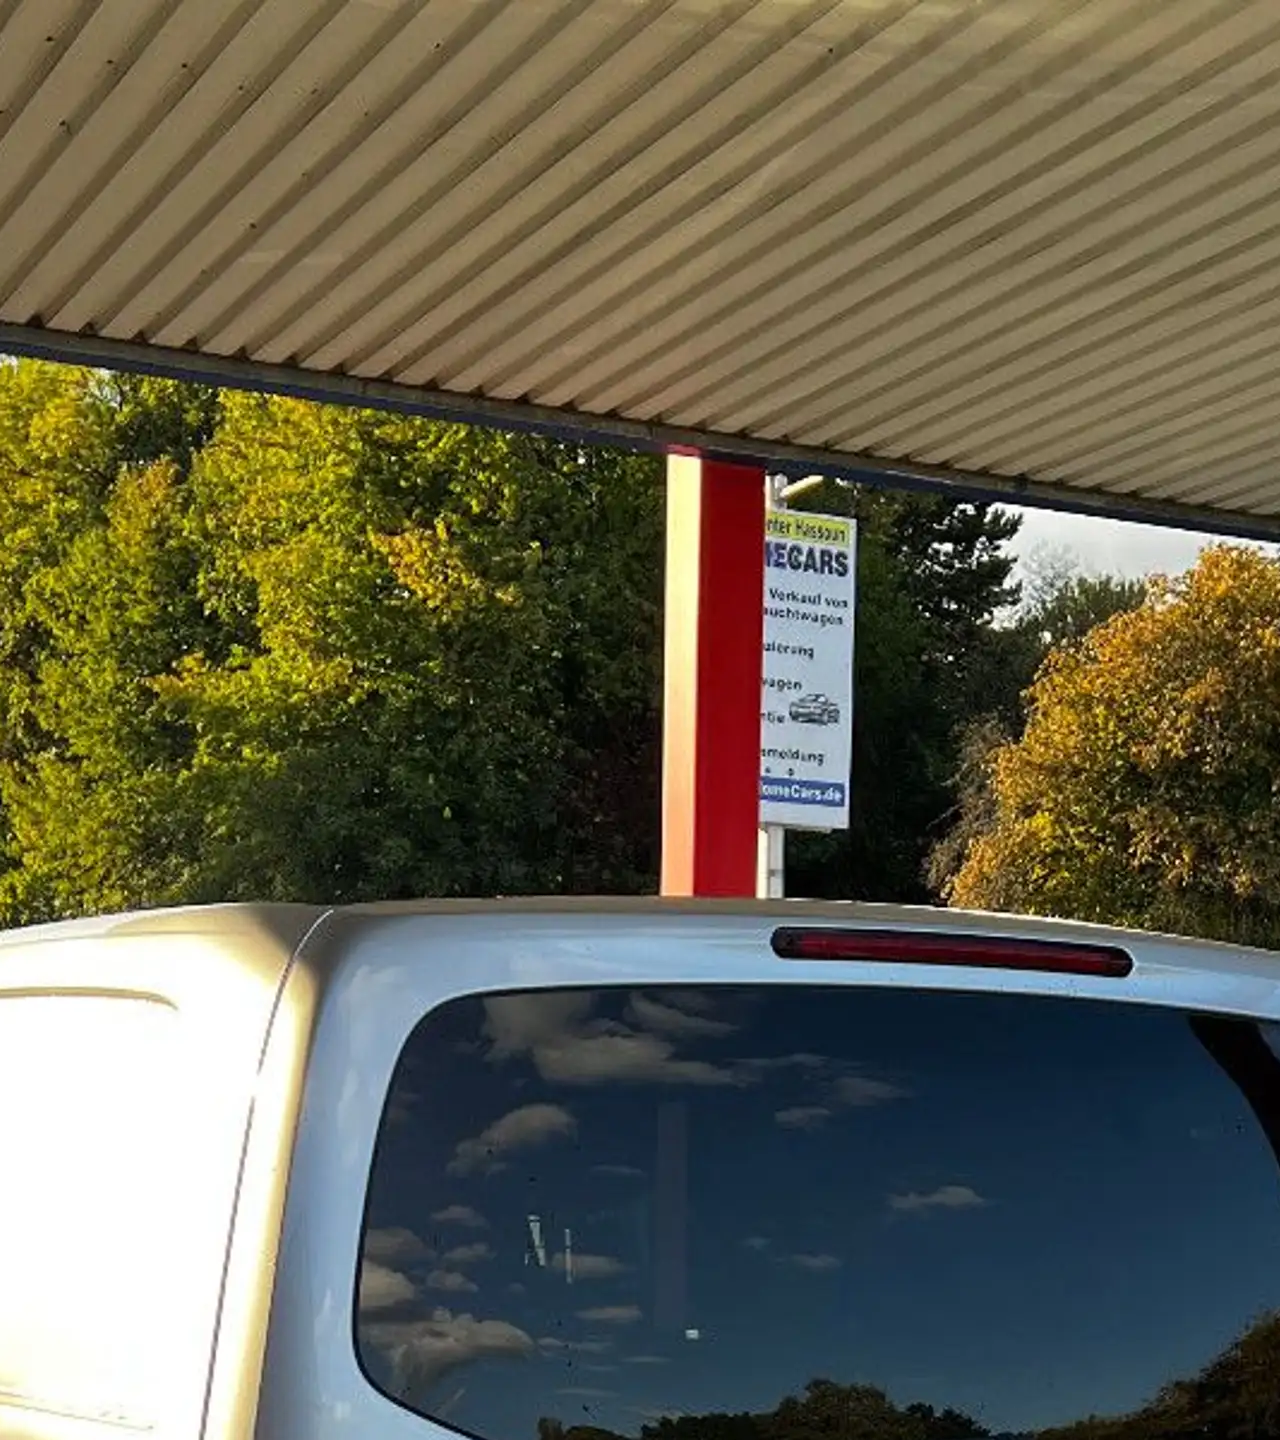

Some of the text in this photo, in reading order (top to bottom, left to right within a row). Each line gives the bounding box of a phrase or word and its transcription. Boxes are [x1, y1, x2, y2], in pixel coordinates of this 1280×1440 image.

[769, 588, 848, 608] Verkauf von
[762, 785, 843, 802] omeCars.de
